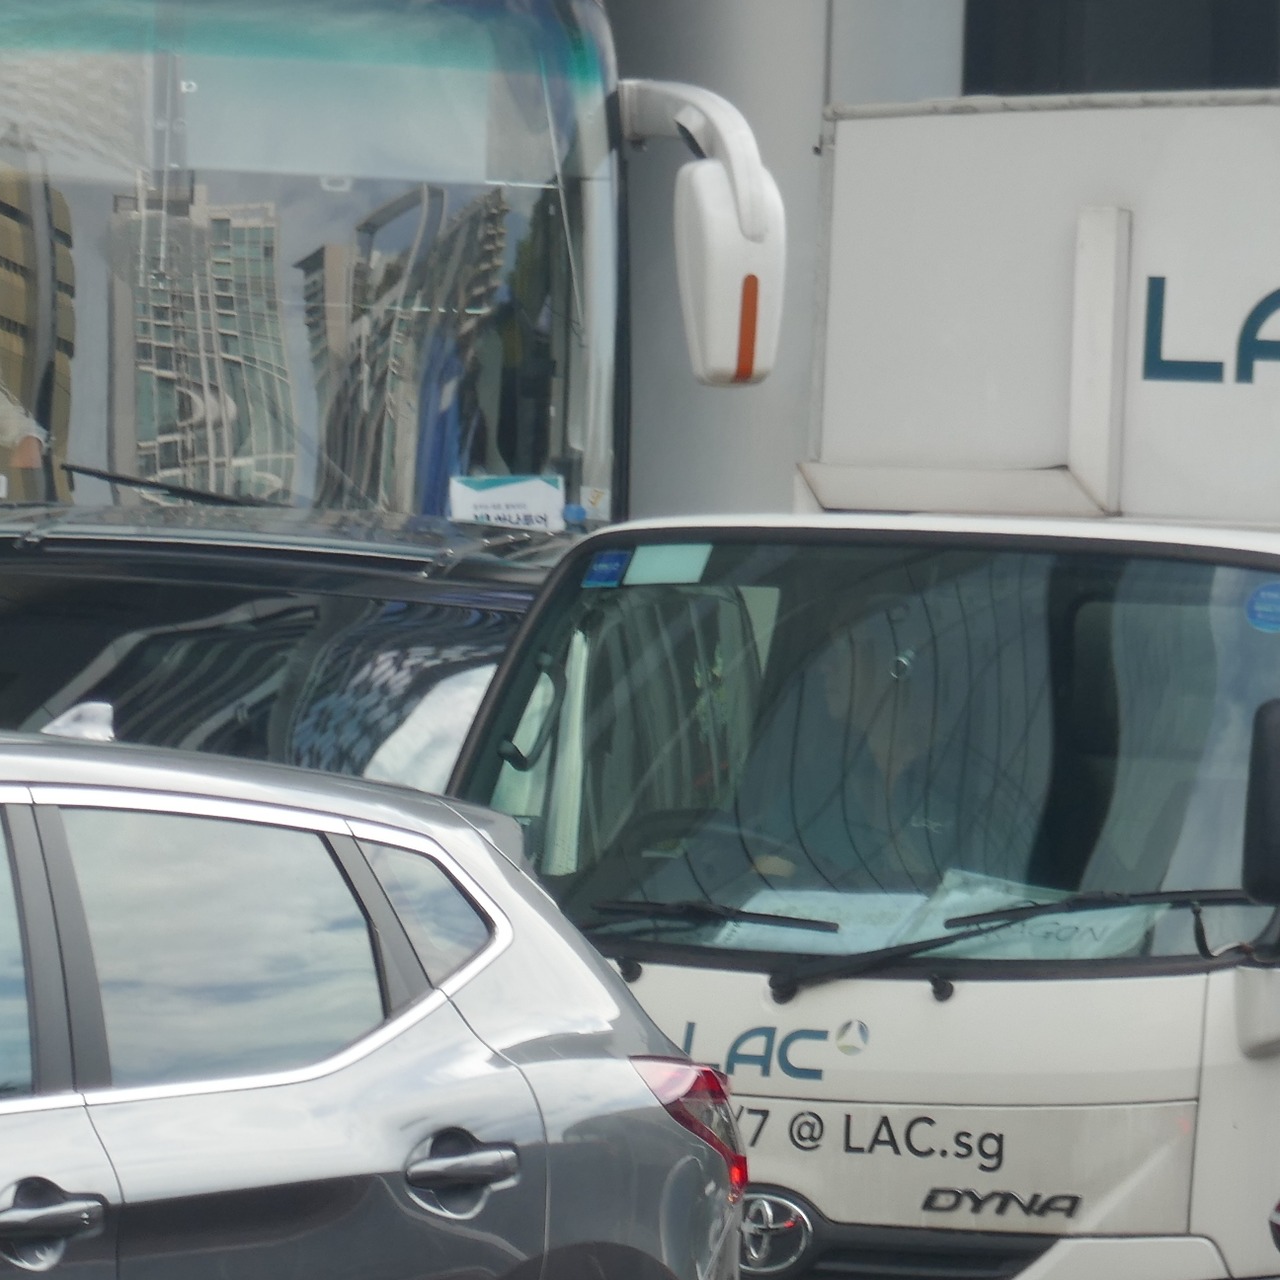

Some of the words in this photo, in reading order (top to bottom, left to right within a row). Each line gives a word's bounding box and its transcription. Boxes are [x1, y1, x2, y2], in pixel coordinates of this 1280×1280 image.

[683, 1021, 829, 1081] LAC
[789, 1110, 824, 1151] @
[843, 1113, 1005, 1173] LAC.sg
[921, 1187, 1083, 1219] DYNA
